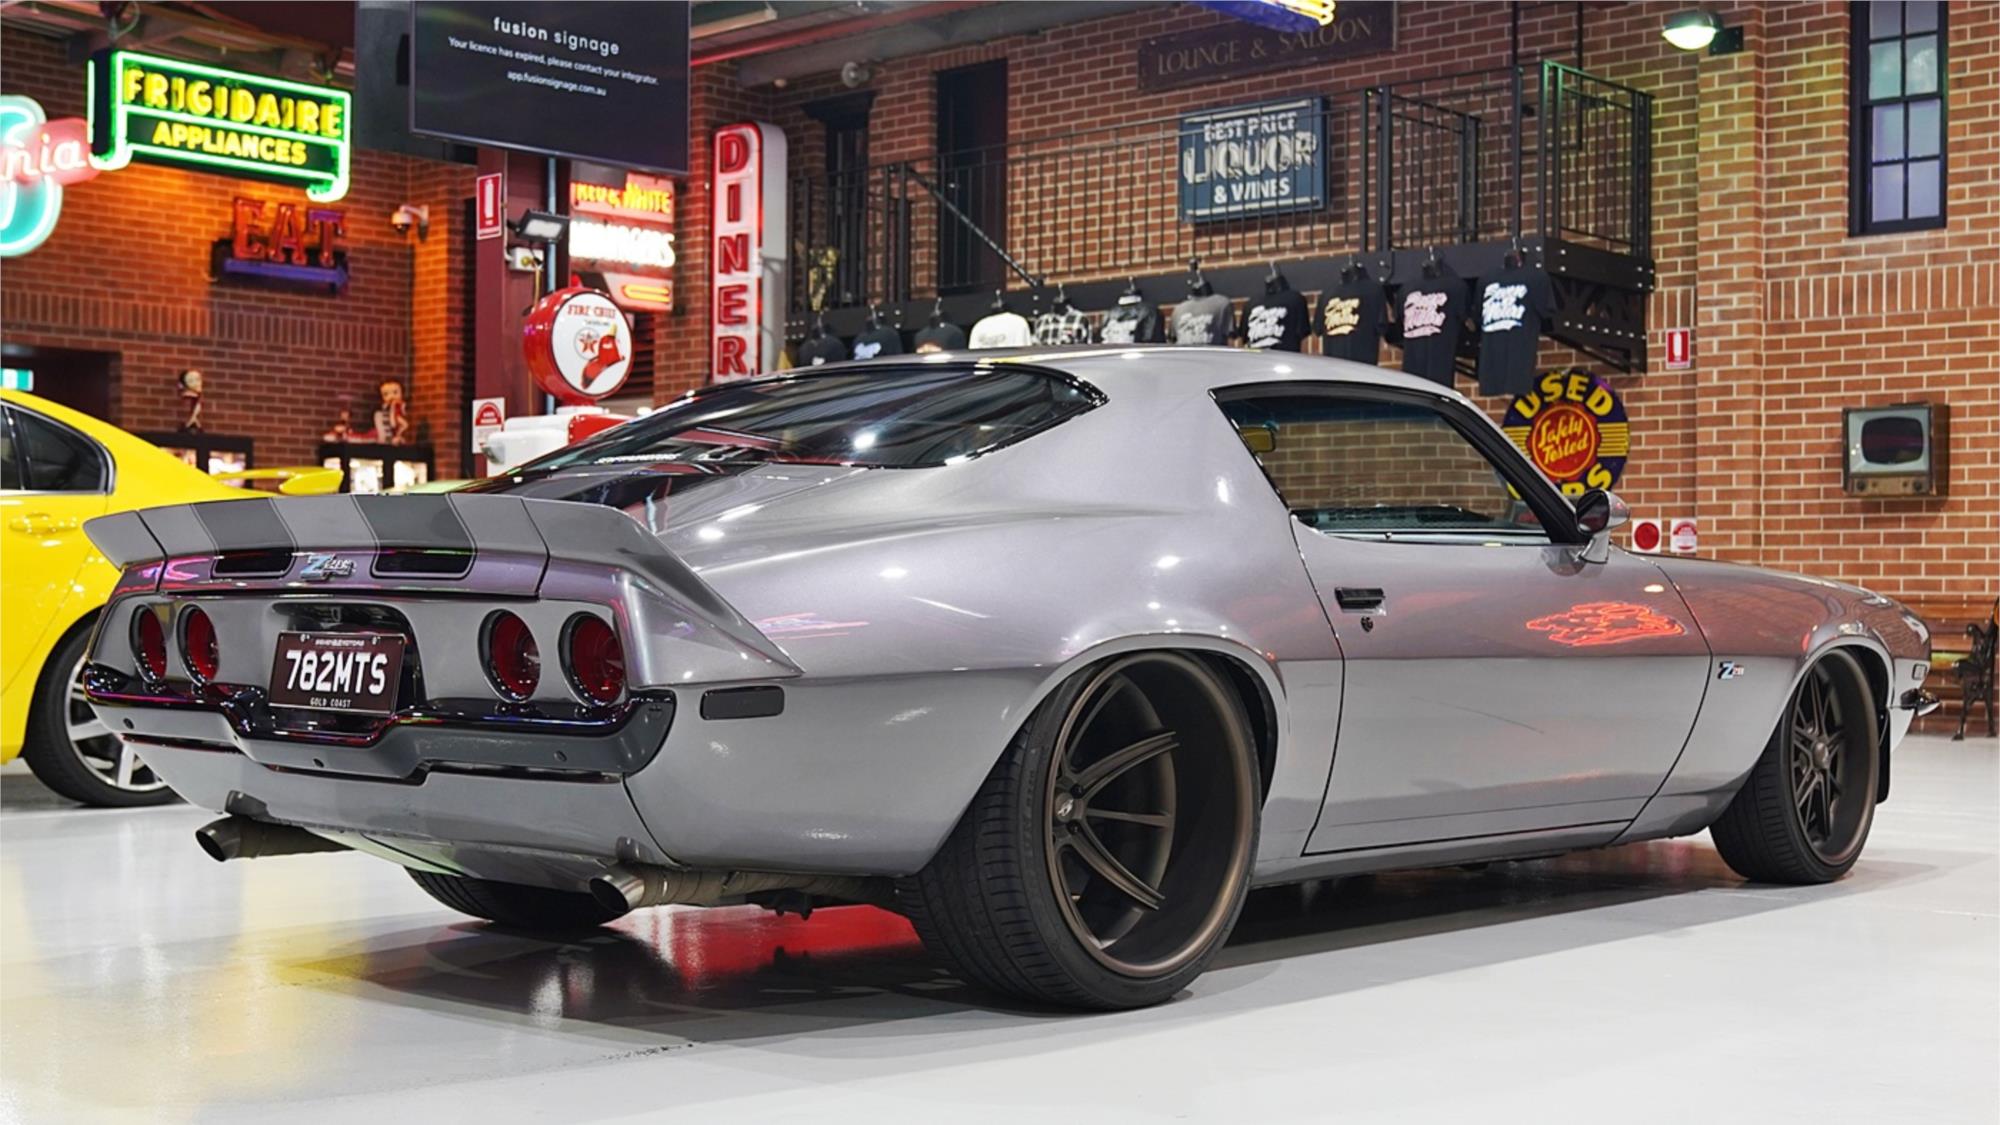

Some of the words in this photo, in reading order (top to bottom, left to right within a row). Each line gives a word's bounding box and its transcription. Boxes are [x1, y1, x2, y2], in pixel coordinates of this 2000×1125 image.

[448, 36, 468, 50] Your
[468, 40, 497, 56] licence
[499, 46, 513, 59] has
[547, 56, 573, 70] please
[574, 60, 601, 75] contact
[603, 66, 620, 80] your
[493, 16, 548, 41] fusion
[554, 30, 620, 57] signage
[1157, 39, 1242, 76] LOUNGE
[1250, 38, 1268, 60] &
[1278, 15, 1374, 51] SALOON
[122, 68, 343, 138] FRIGIDAIRE
[507, 70, 607, 97] app.fusionsignage.com.au
[152, 121, 307, 166] APPLIANCES
[1203, 117, 1246, 142] BEST
[1247, 111, 1298, 136] PRICE
[1182, 130, 1318, 185] LIQUOR
[1213, 184, 1228, 205] &
[1231, 177, 1292, 203] WINES
[232, 197, 346, 267] EAT
[717, 134, 750, 376] DINER
[1514, 372, 1614, 419] USED
[1541, 431, 1589, 465] Tested
[286, 649, 388, 695] 782MTS
[310, 697, 327, 707] GOLD
[330, 698, 351, 708] COAST
